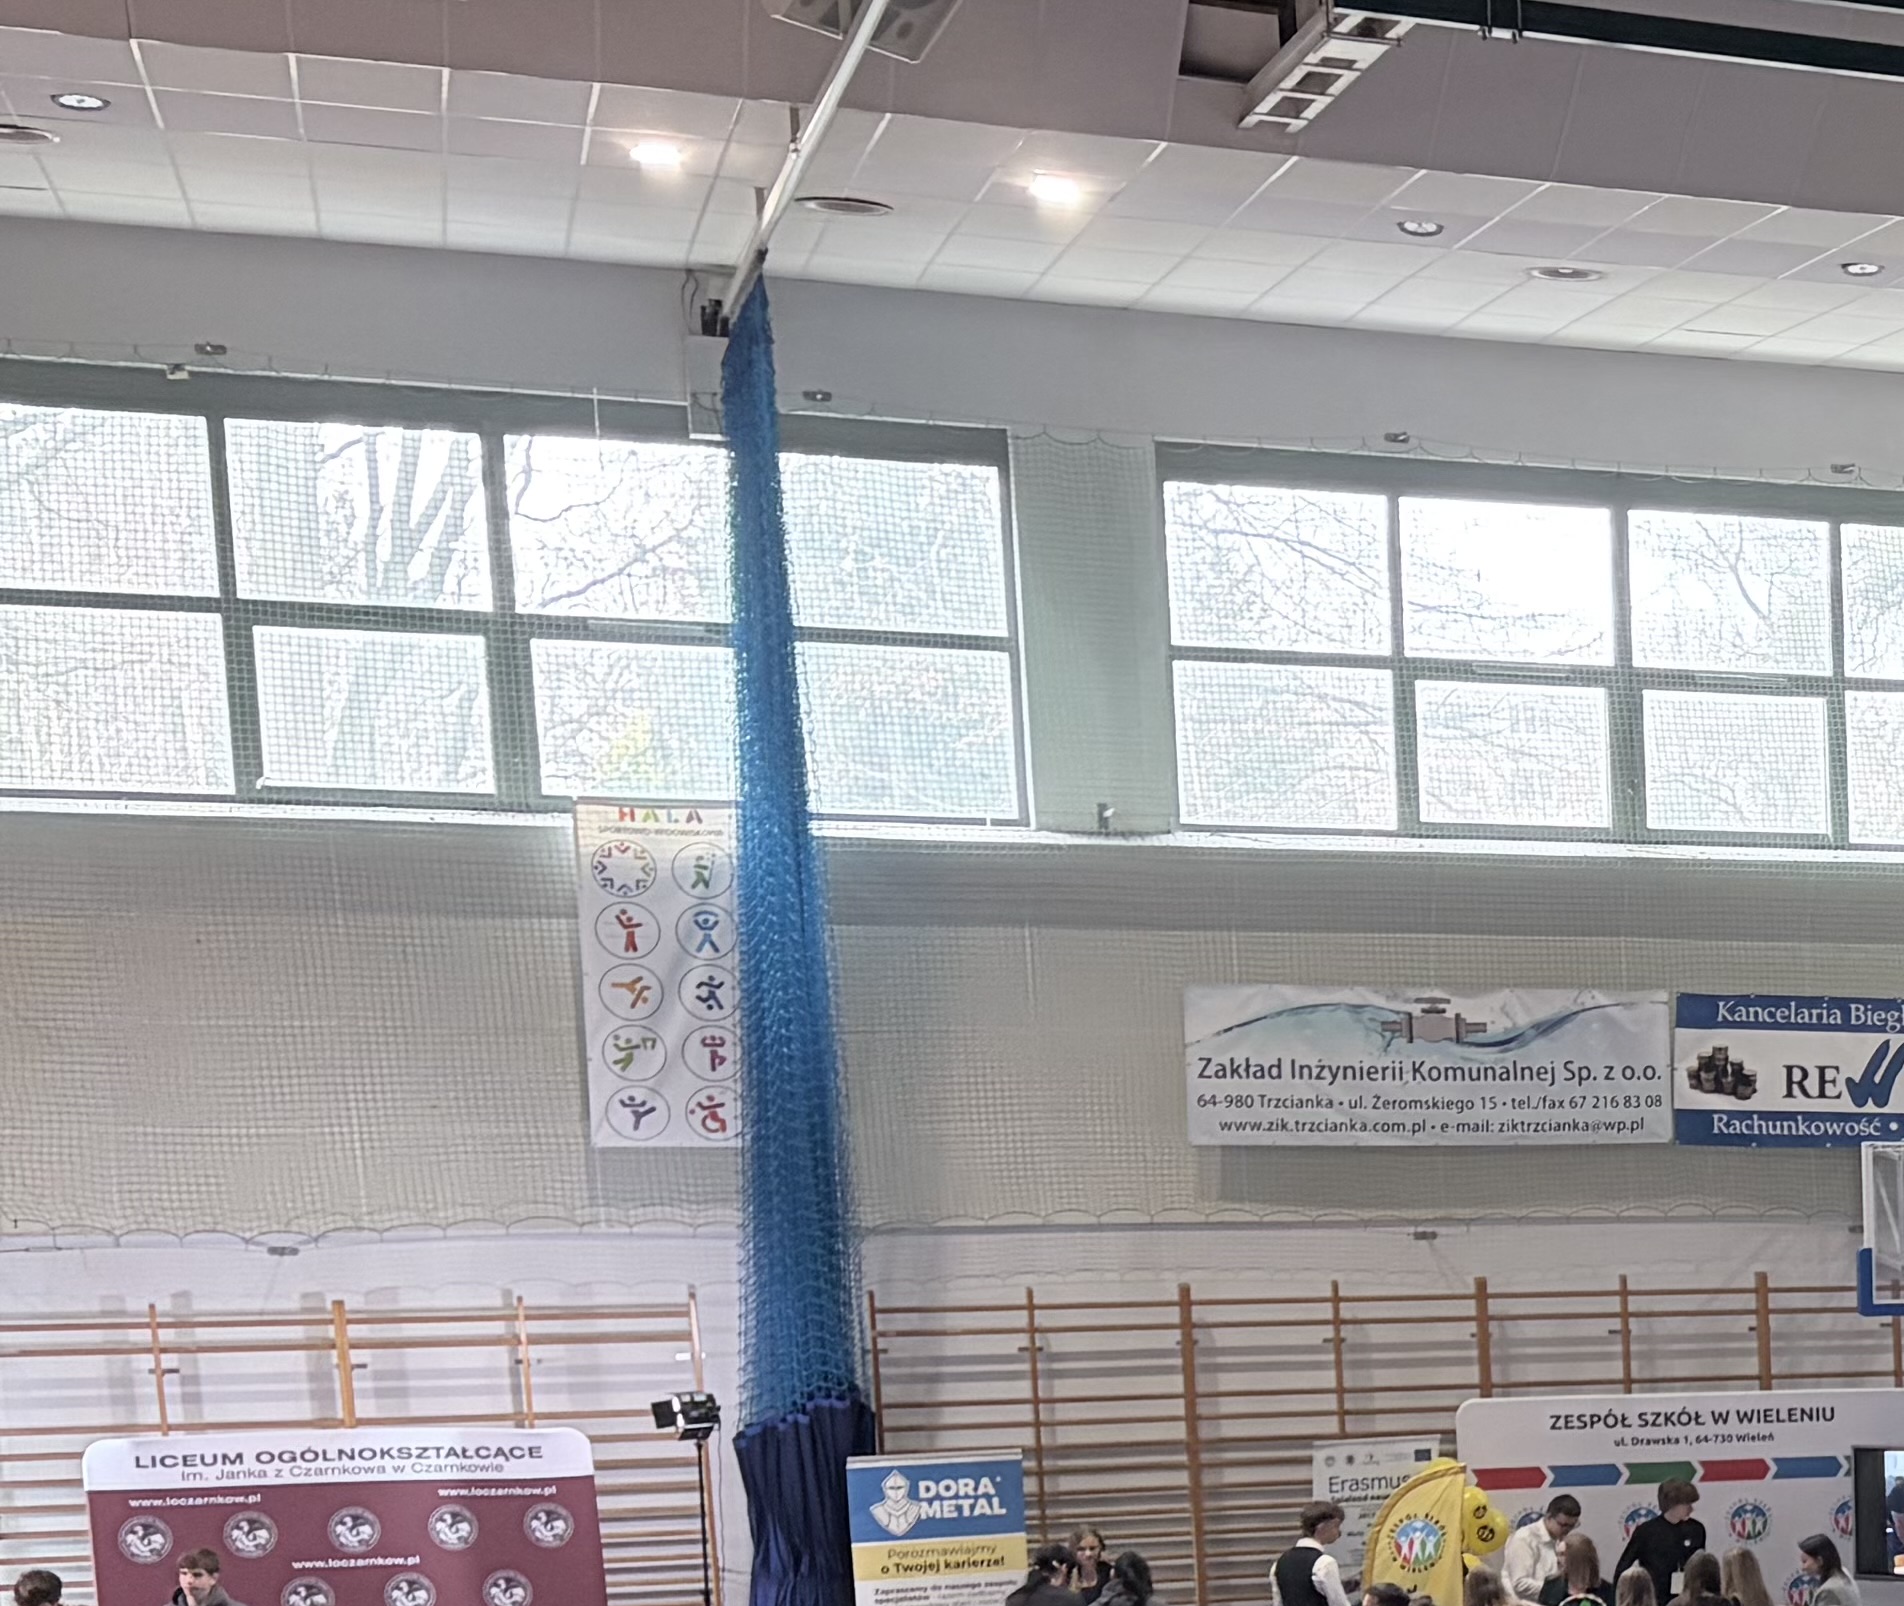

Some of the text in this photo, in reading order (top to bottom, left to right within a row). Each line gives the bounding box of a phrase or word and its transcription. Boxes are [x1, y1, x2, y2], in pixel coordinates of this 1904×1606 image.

[618, 806, 703, 824] HALA
[1717, 1002, 1842, 1026] Kancelaria
[1198, 1056, 1662, 1089] Zakład Inżynierii Komunalnej Sp. z o.o.
[1197, 1091, 1662, 1115] 64-980 Trzcianka ul. Żeromskiego 15 tel./fax 67 216 83 08
[1219, 1117, 1645, 1138] www.zik.trzcianka.com.pl e-mail: ziktrzcianka@wp.pl
[1712, 1113, 1881, 1137] Rachunkowość
[1549, 1406, 1836, 1431] ZESPÓŁ SZKÓŁ W WIELENIU
[1630, 1434, 1679, 1447] Drawska
[1695, 1433, 1733, 1446] 64-730
[1736, 1431, 1775, 1445] Wieleń
[134, 1443, 544, 1469] LICEUM OGÓLNOKSZTAŁCĄCE
[216, 1460, 504, 1480] Janka z Czarnkowa w Czarnkowie
[918, 1477, 996, 1499] DORA
[919, 1497, 1006, 1520] METAL
[887, 1544, 997, 1560] Porozmawiajmy
[881, 1556, 1005, 1575] o Twojej karierze!
